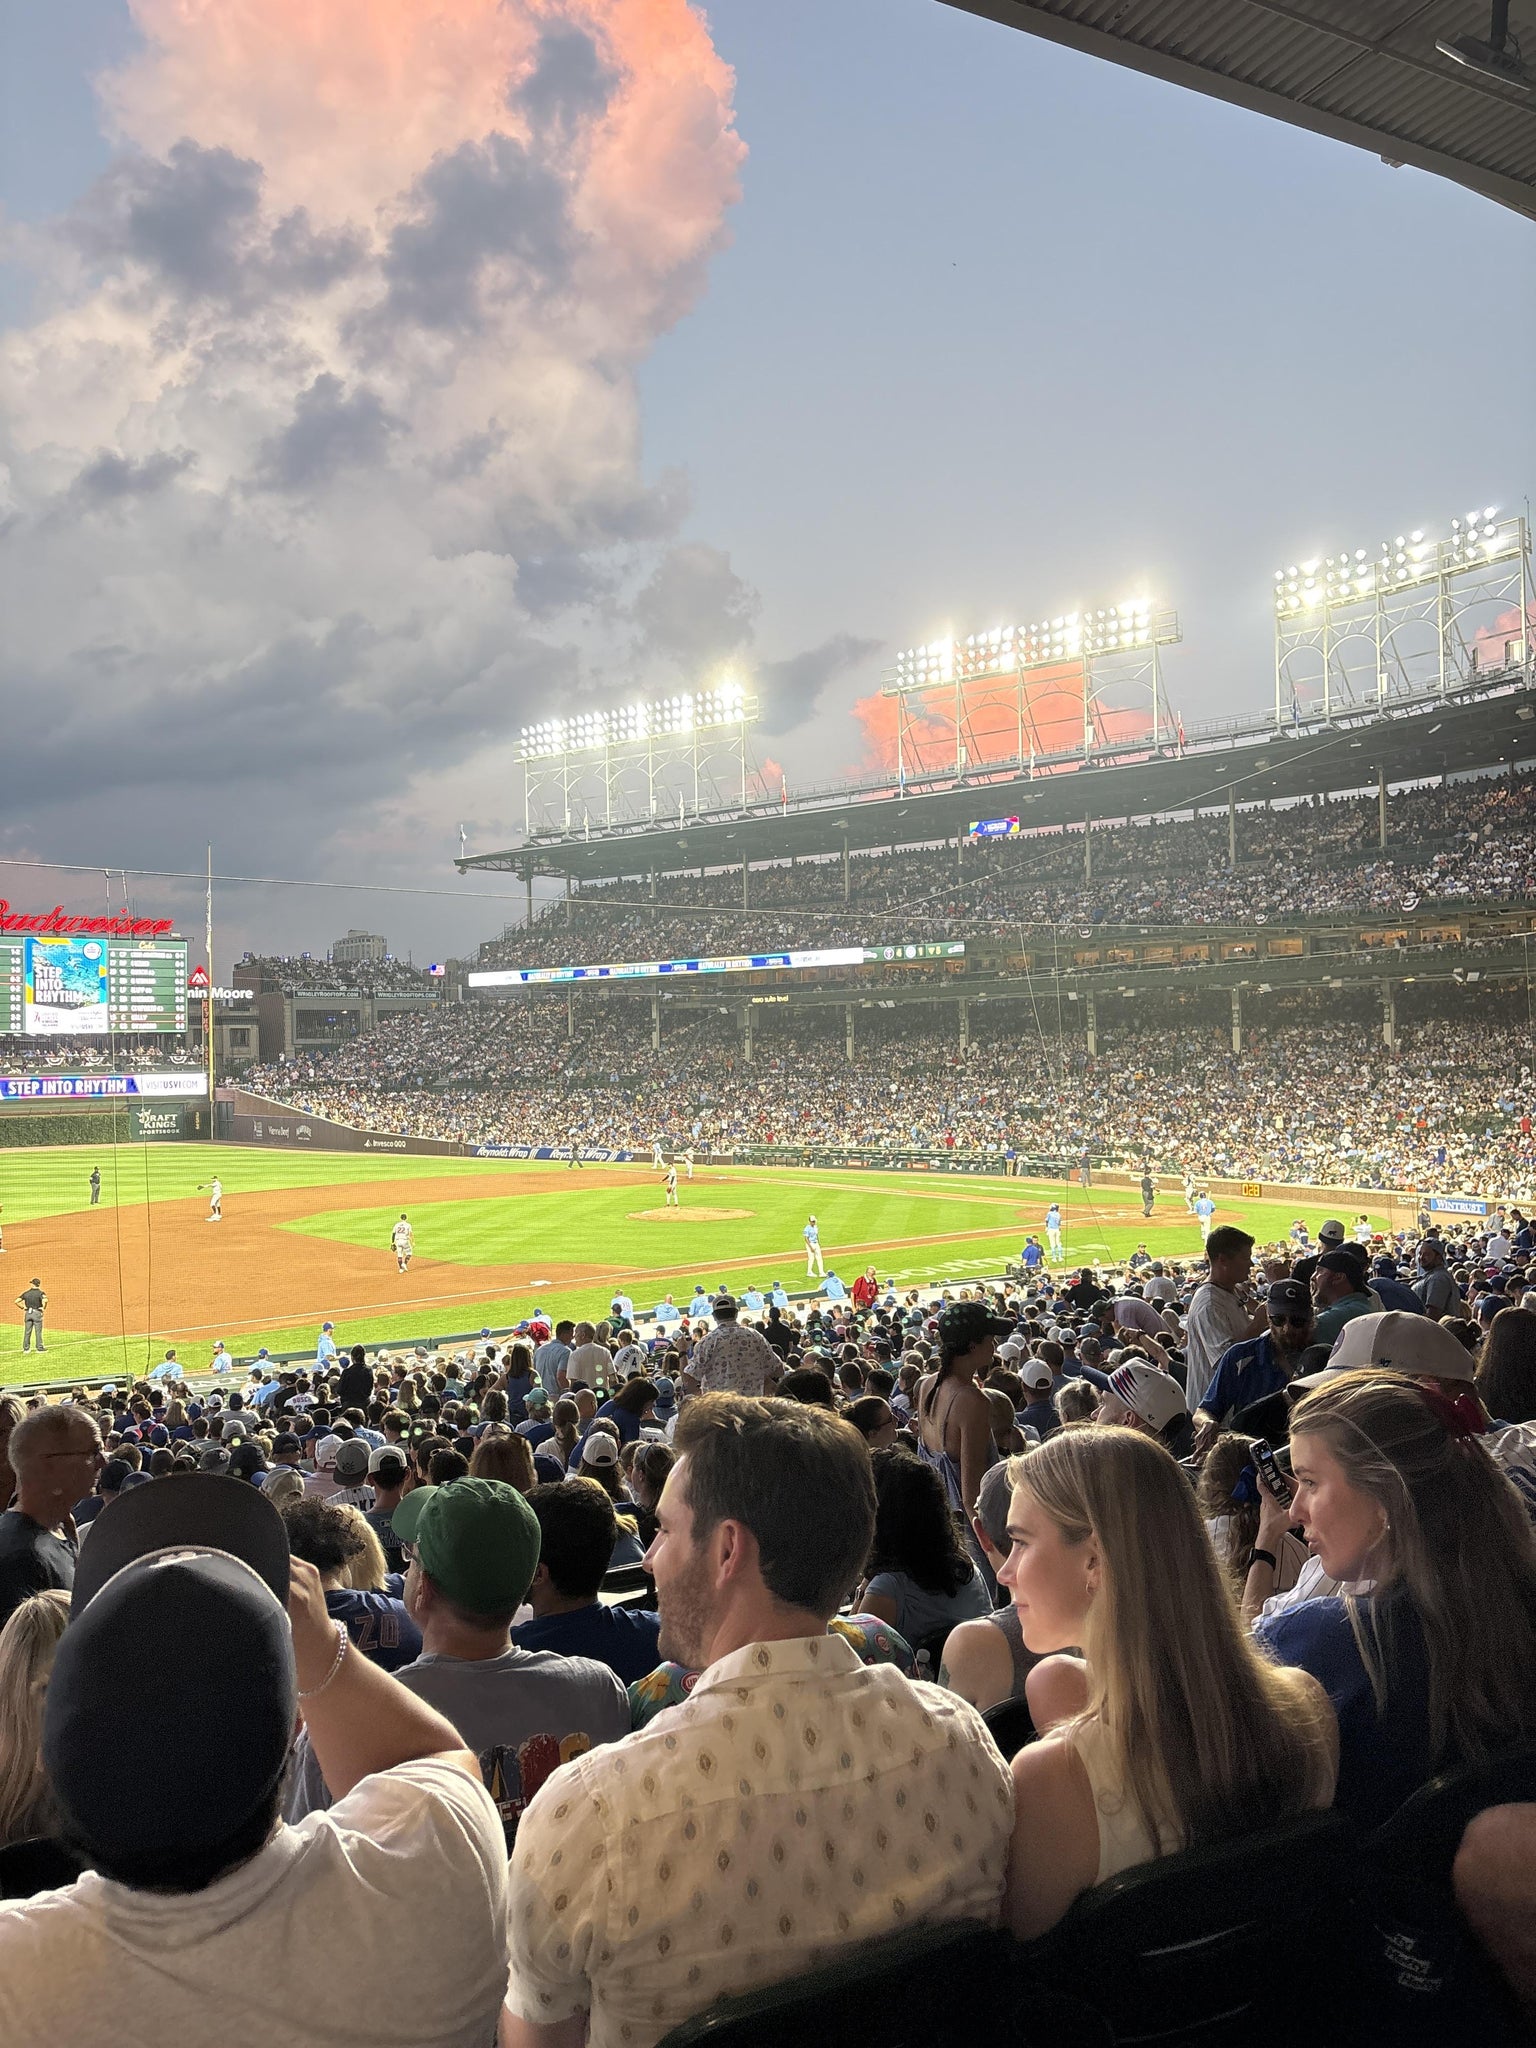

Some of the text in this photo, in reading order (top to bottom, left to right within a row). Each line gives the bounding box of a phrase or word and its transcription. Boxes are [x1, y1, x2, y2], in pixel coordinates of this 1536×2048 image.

[34, 967, 63, 978] STEP
[35, 979, 63, 990] INTO
[36, 990, 84, 1003] RHYTHM
[212, 987, 254, 999] Moore
[8, 1081, 38, 1095] STEP
[42, 1080, 73, 1094] INTO
[75, 1079, 127, 1093] RHYTHM
[144, 1121, 177, 1129] KINGS
[373, 1139, 394, 1148] Invesco
[476, 1147, 528, 1160] Reynolds Wrap
[584, 1150, 608, 1161] Wrap
[1242, 1184, 1260, 1197] 028
[1437, 1199, 1484, 1213] WINTRUST
[397, 1226, 406, 1234] 22
[631, 1356, 638, 1368] 4
